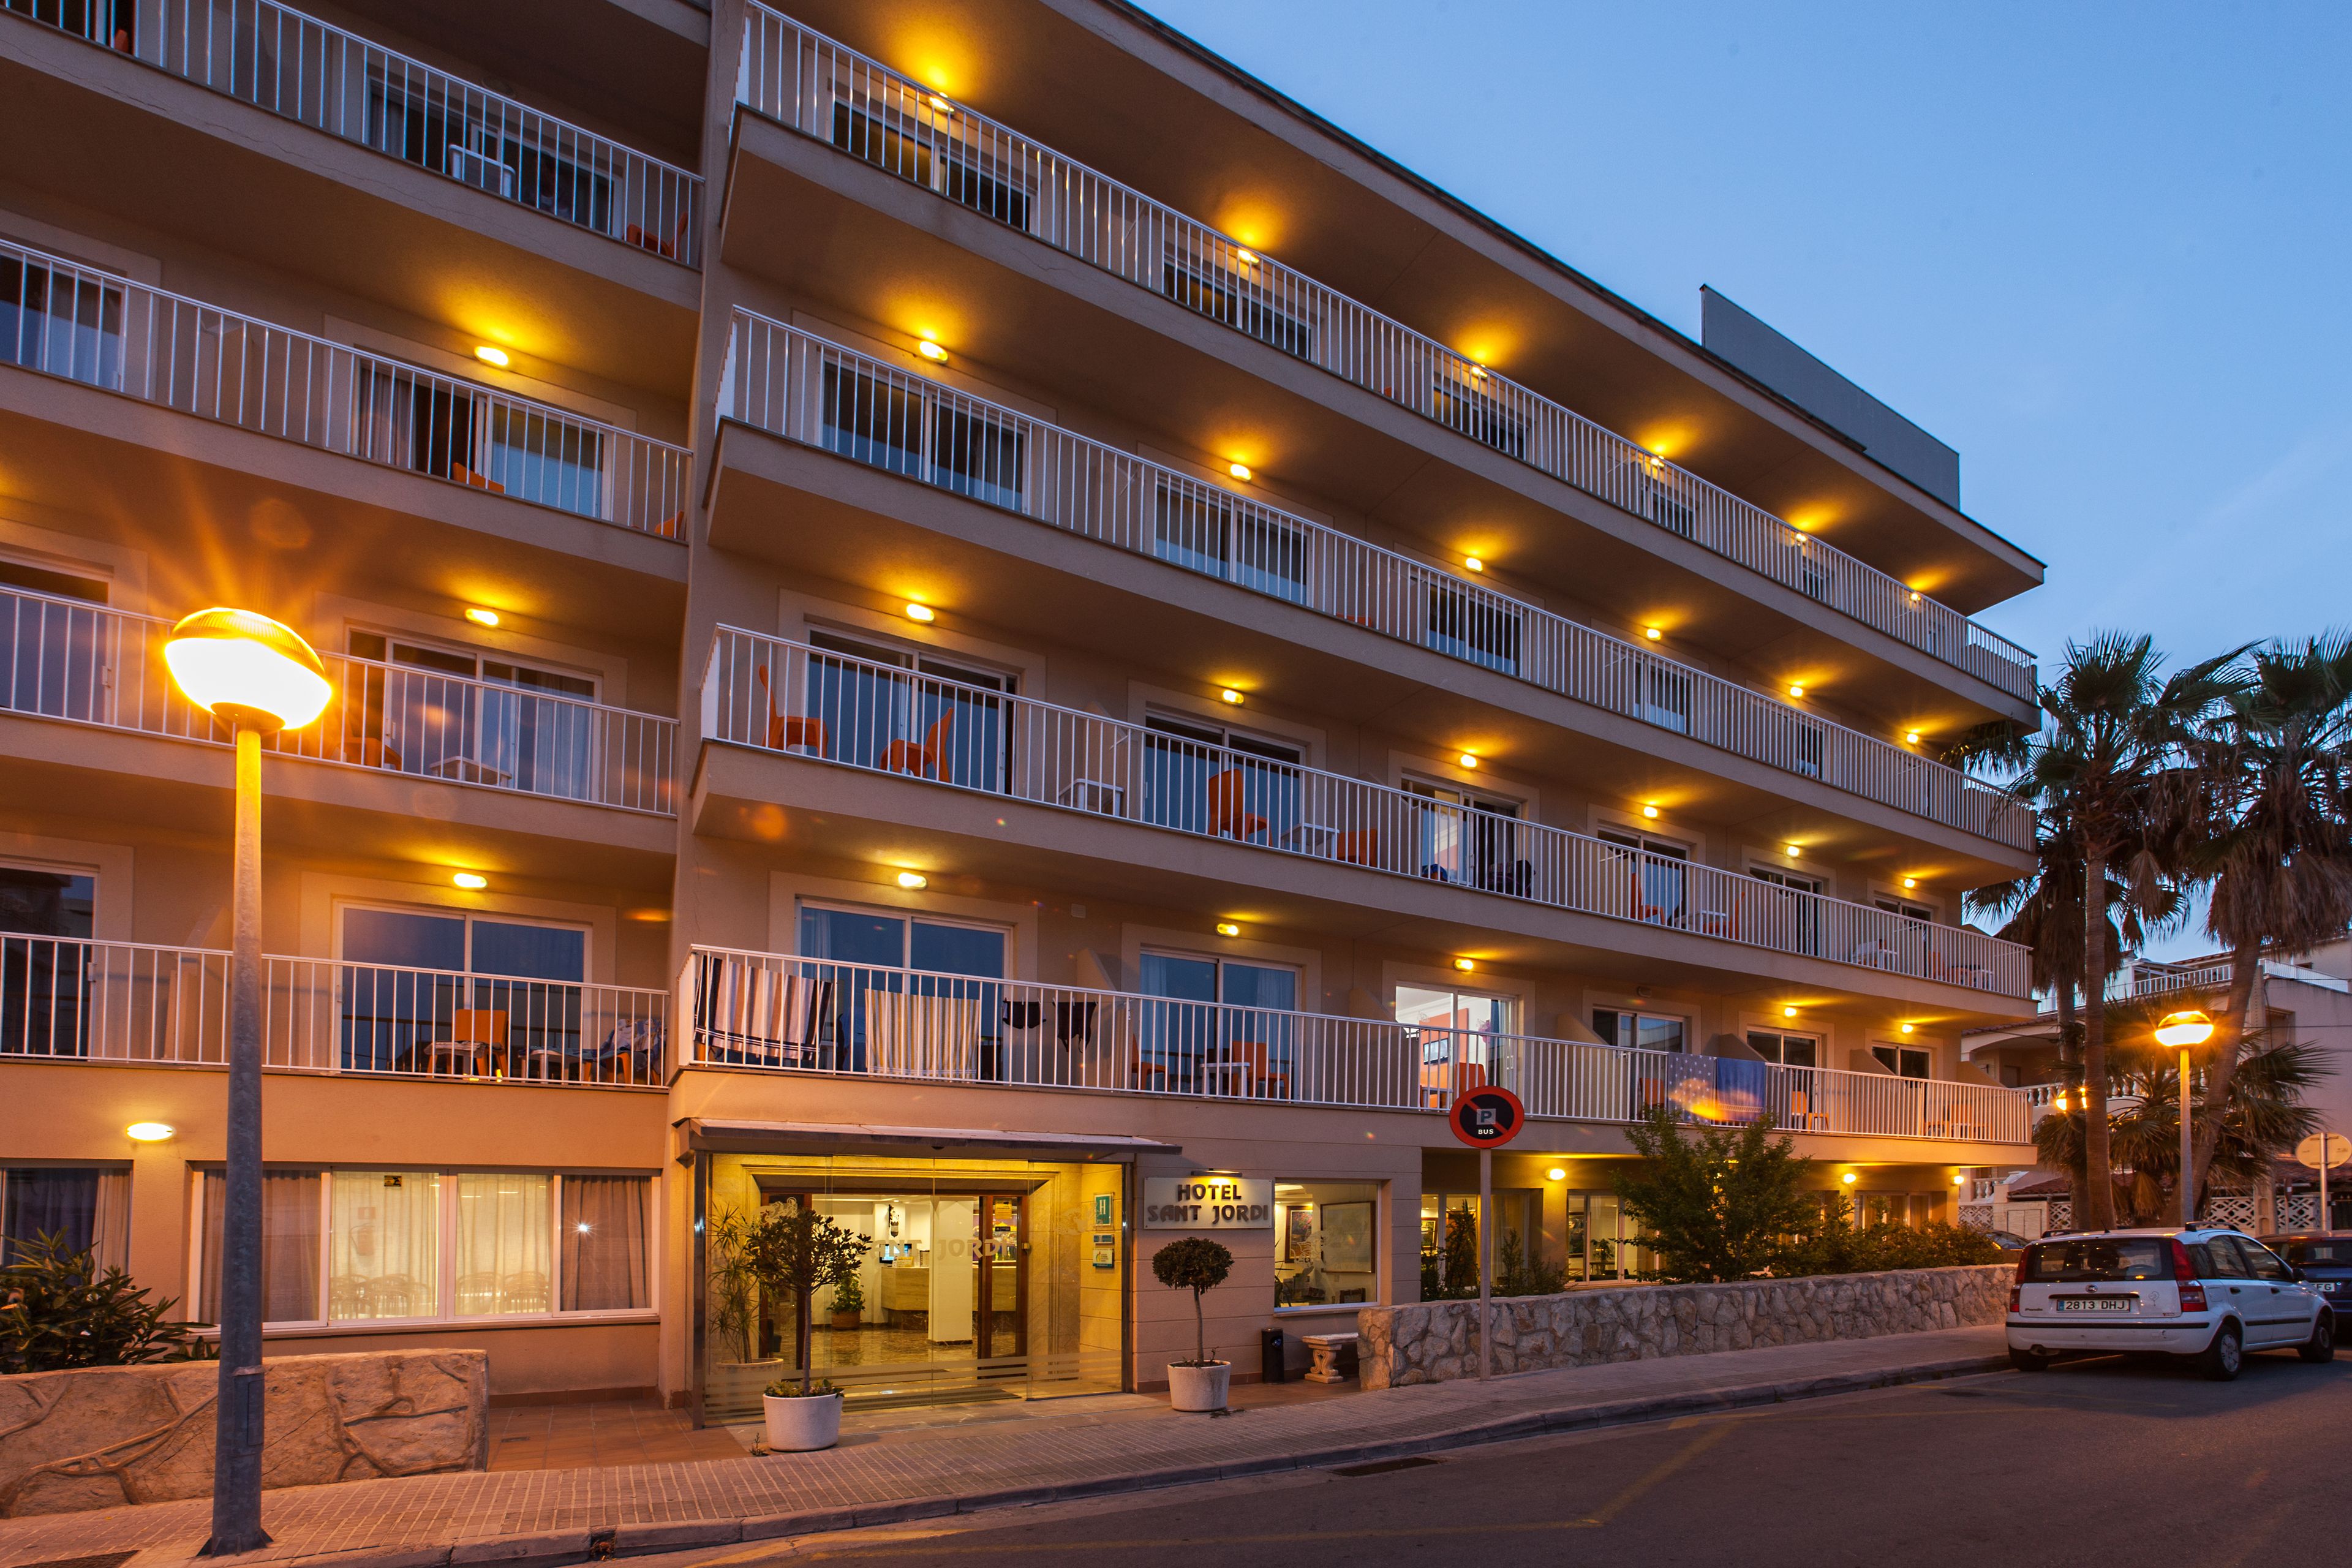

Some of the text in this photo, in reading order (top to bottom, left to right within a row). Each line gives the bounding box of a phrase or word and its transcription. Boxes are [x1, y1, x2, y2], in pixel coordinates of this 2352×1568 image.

[1480, 1110, 1492, 1123] P
[1177, 1184, 1242, 1202] HOTEL
[1099, 1199, 1106, 1215] H
[1147, 1204, 1268, 1225] SANT JORDI
[858, 1238, 1007, 1261] ANT JORDI
[2065, 1300, 2125, 1310] 2813 DHJ
